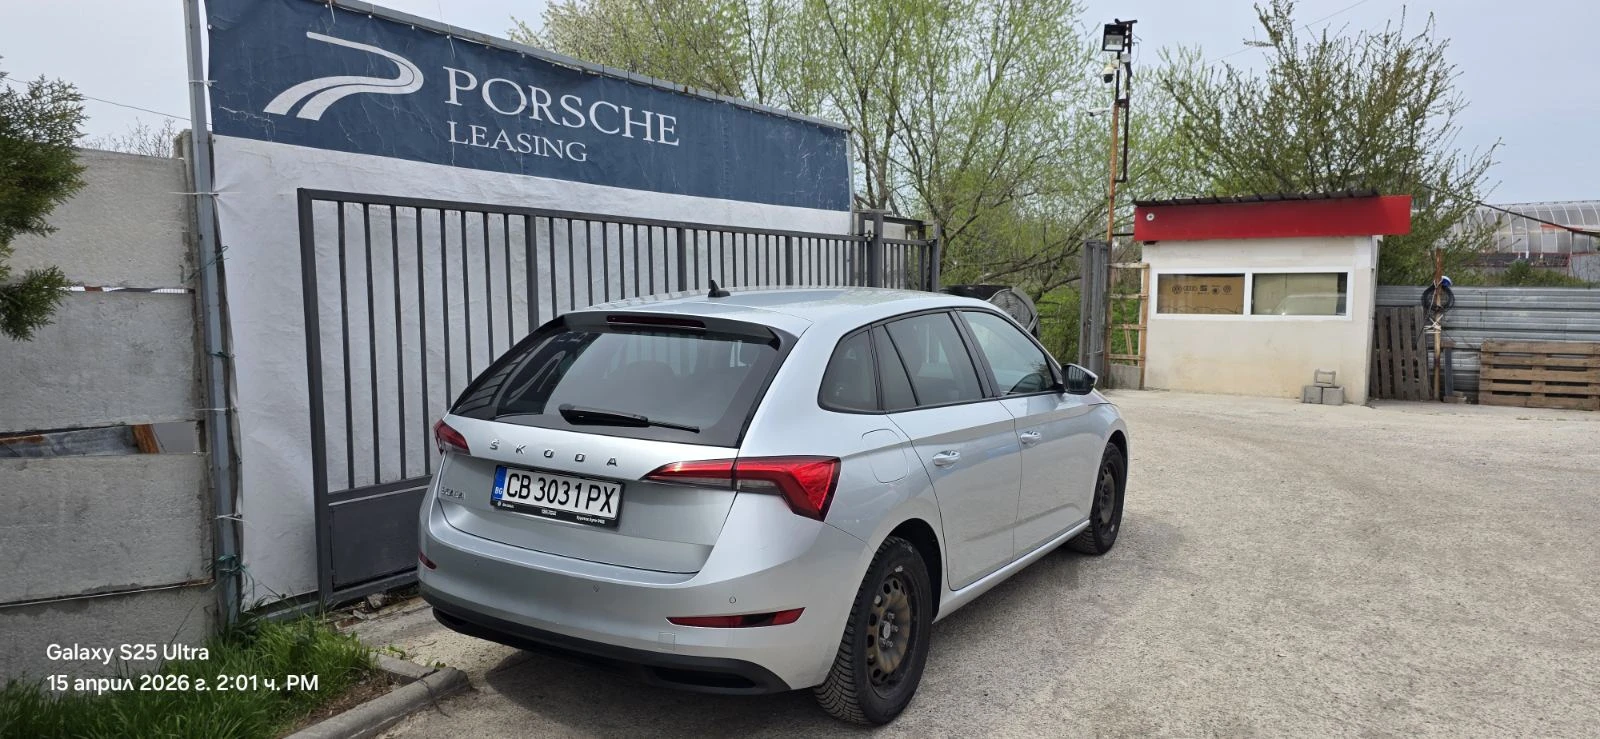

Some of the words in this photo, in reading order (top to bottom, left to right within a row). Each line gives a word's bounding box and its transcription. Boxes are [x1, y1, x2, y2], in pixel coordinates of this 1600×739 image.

[443, 66, 680, 146] PORSCHE
[448, 120, 588, 162] LEASING
[494, 486, 504, 495] BG
[506, 473, 532, 500] CB
[534, 477, 583, 509] 3031
[585, 484, 616, 514] PX
